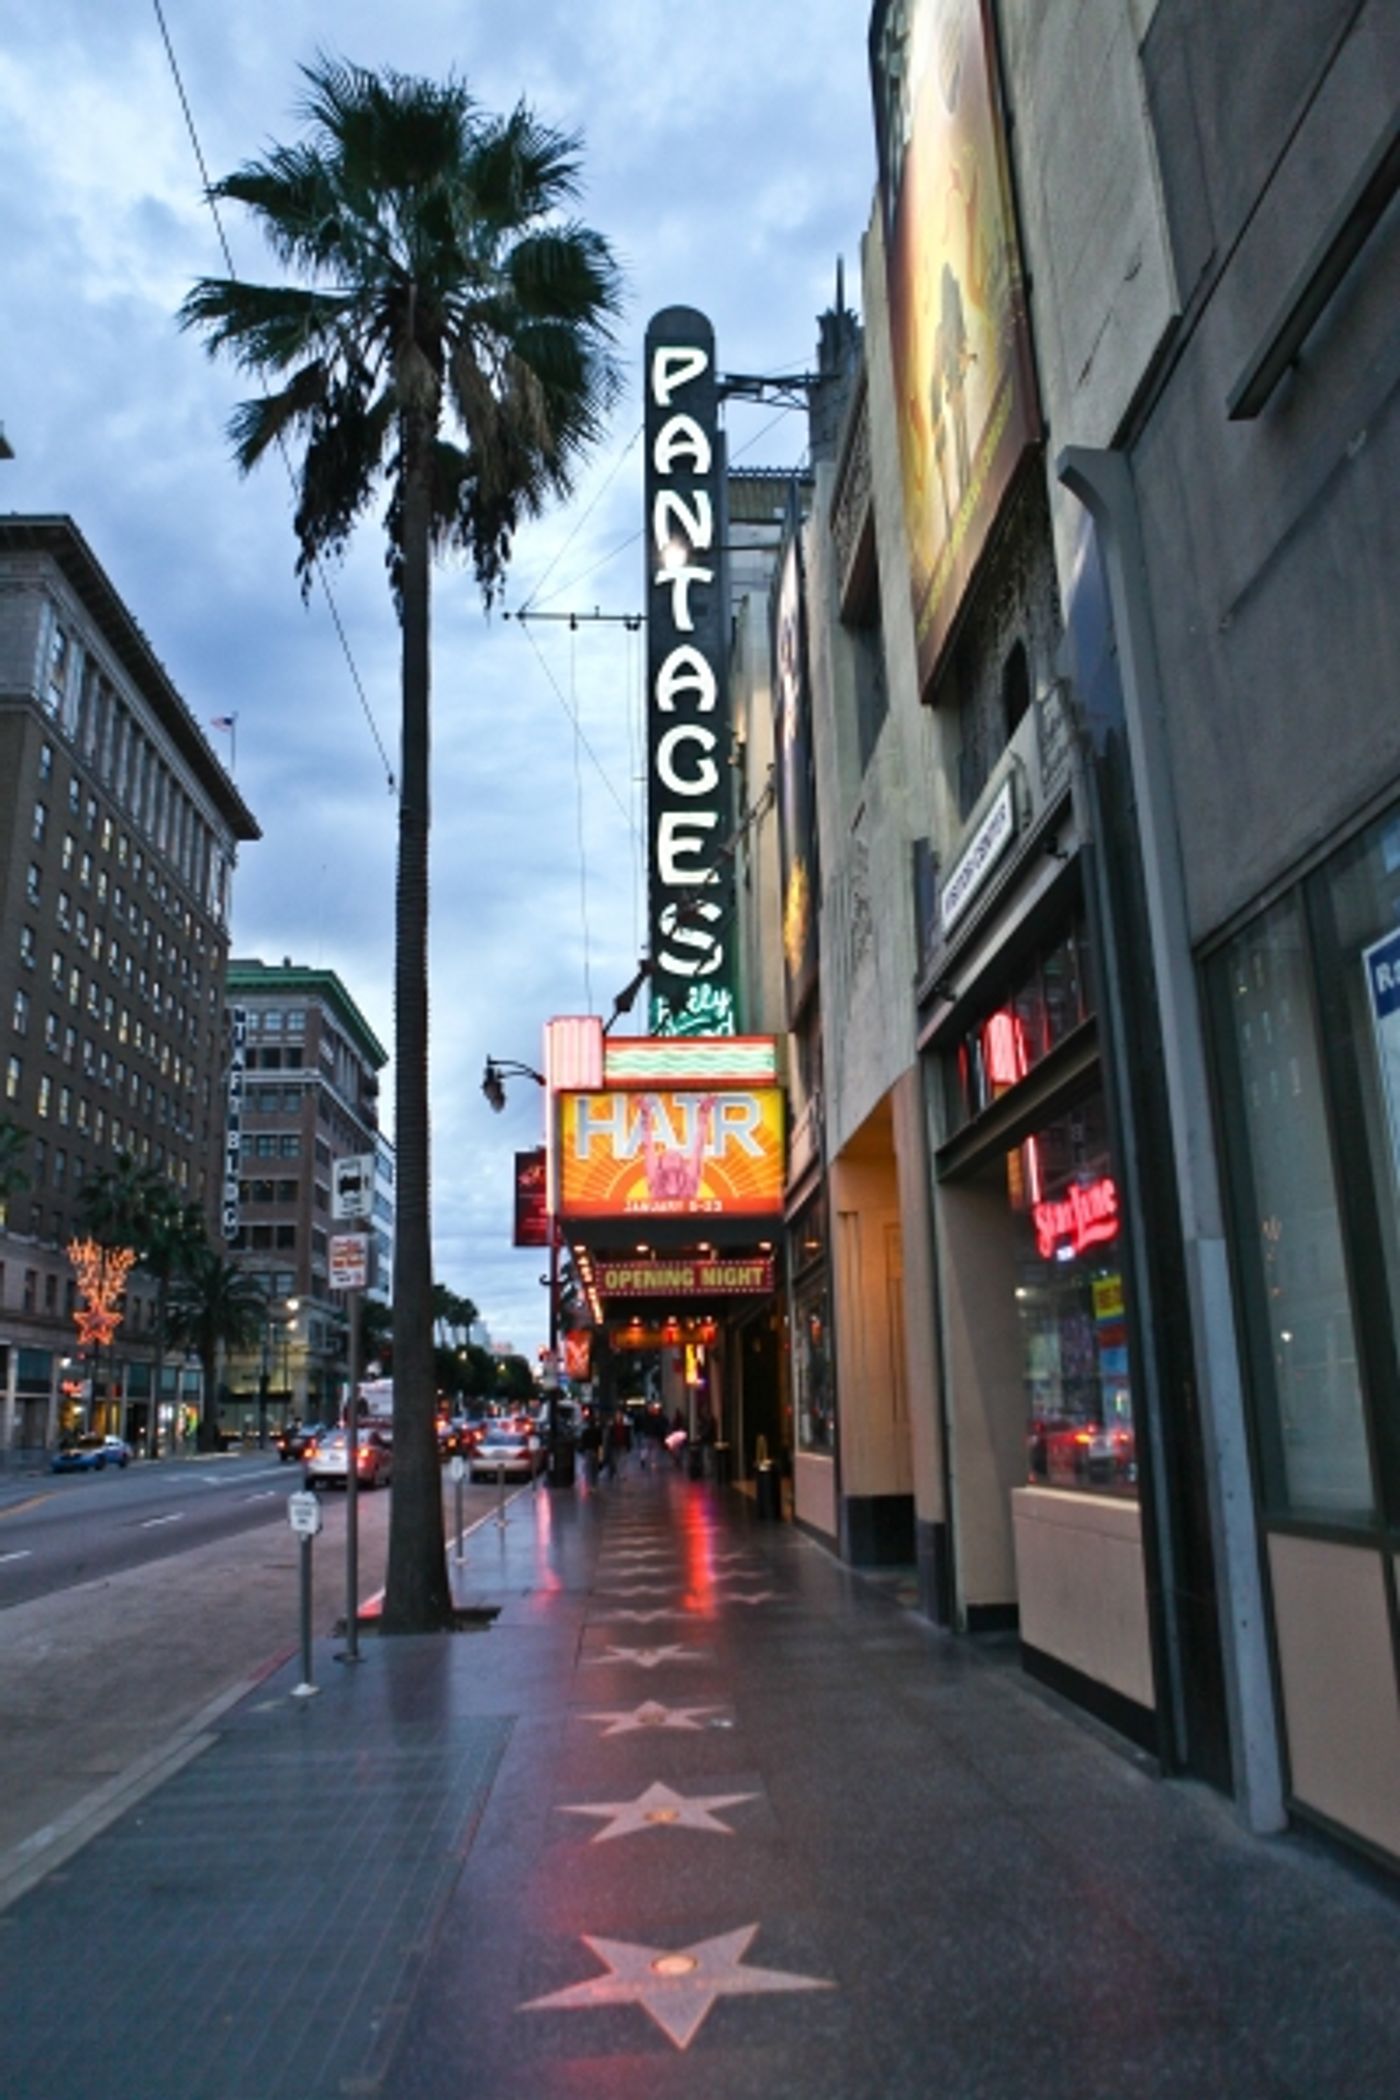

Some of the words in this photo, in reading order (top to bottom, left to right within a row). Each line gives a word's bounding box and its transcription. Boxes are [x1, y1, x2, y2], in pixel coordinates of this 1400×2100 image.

[653, 346, 723, 976] PANTAGES
[574, 1092, 766, 1161] HAIR
[624, 1200, 684, 1214] JANUARY
[605, 1267, 694, 1290] OPENING
[702, 1265, 764, 1287] NIGHT
